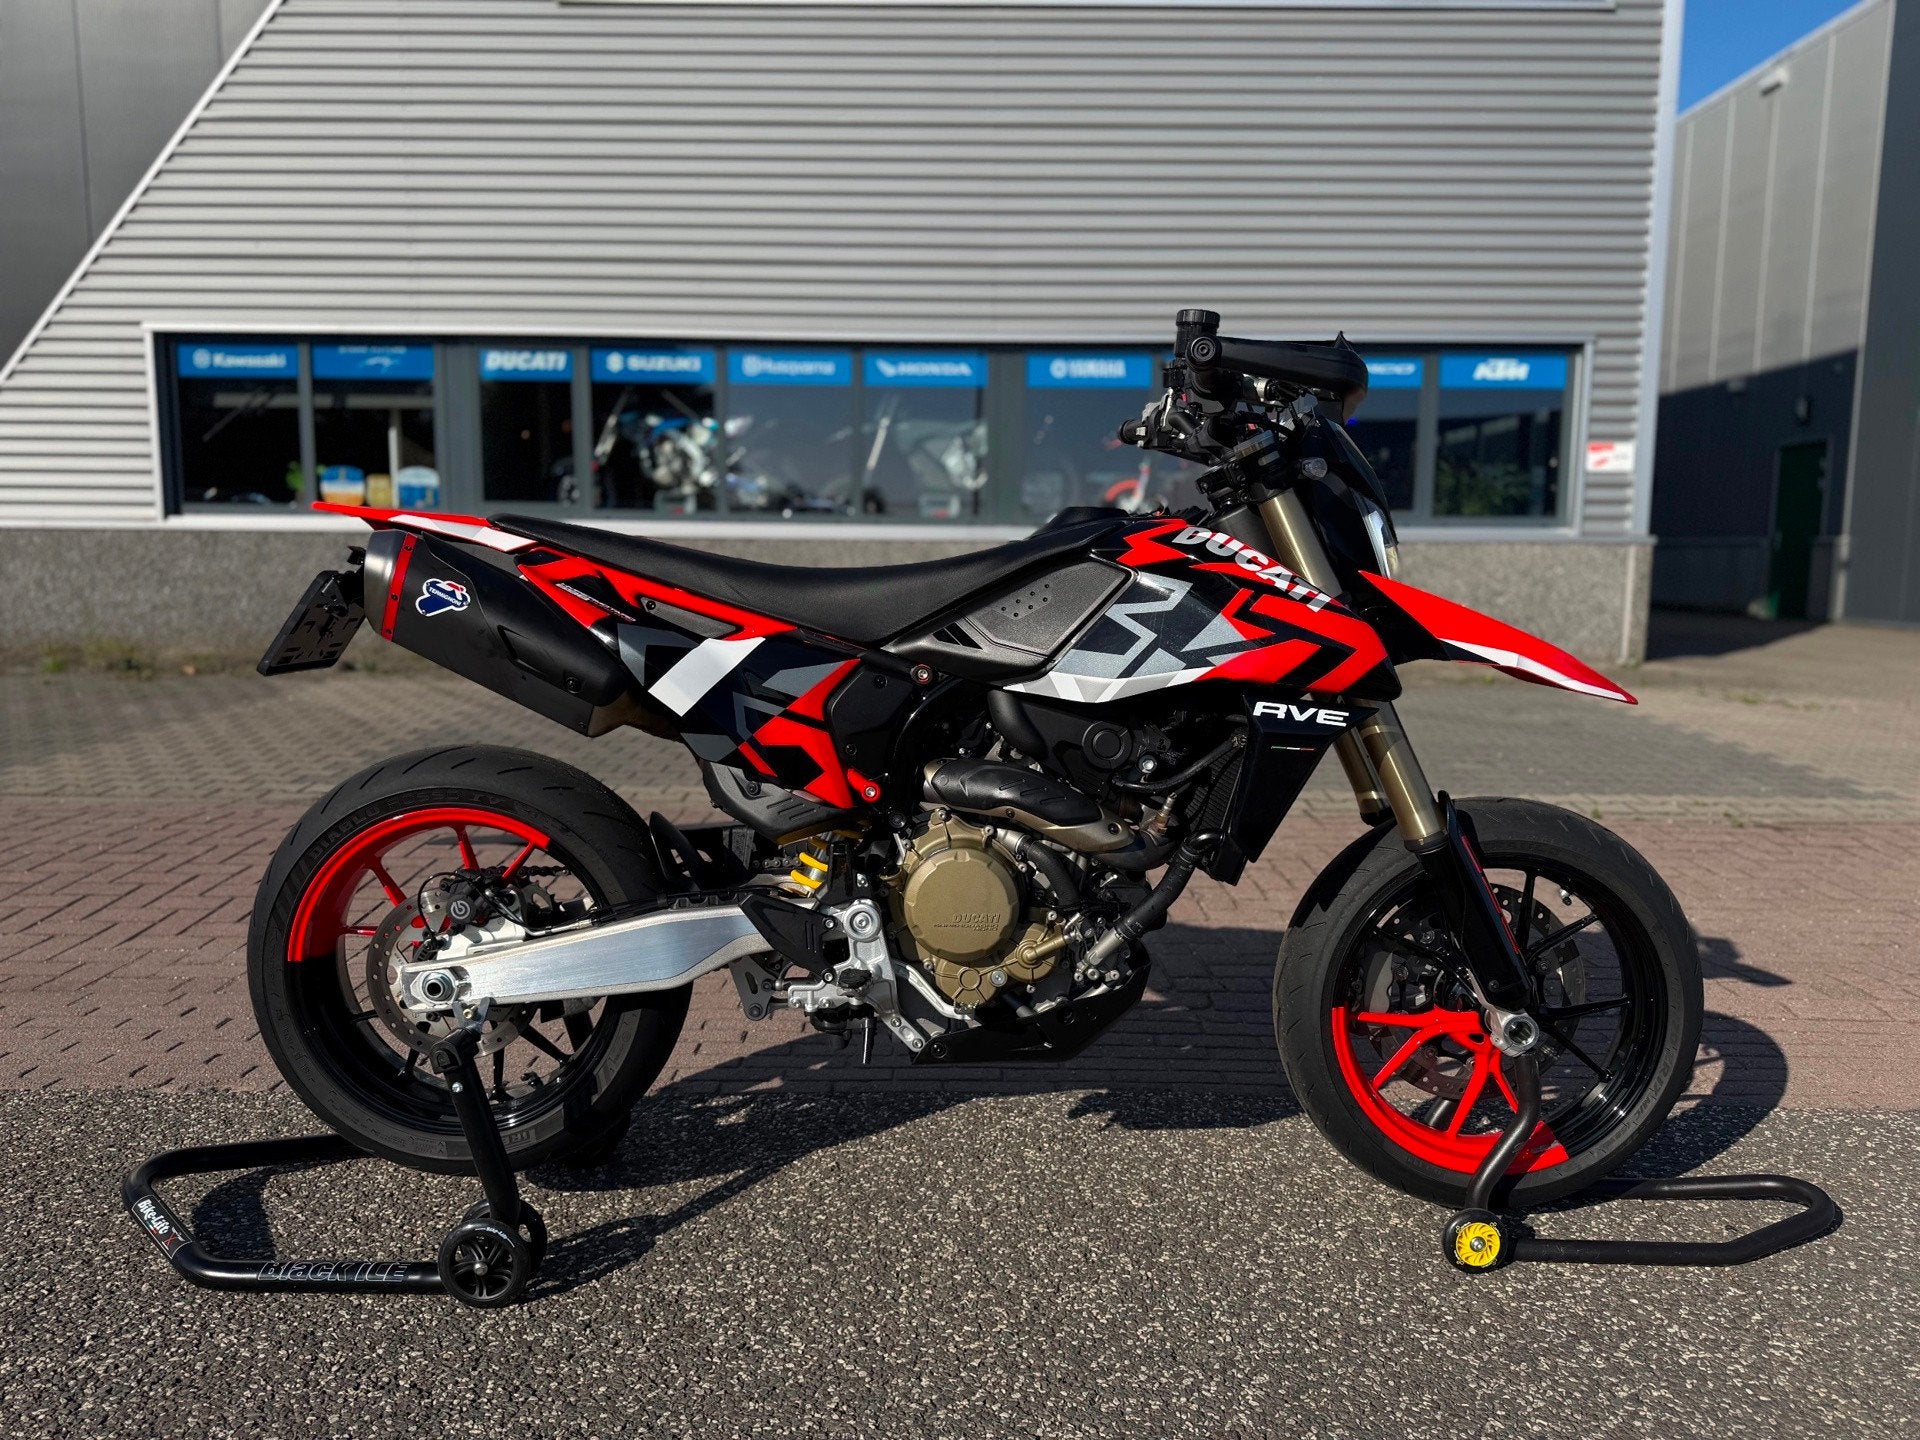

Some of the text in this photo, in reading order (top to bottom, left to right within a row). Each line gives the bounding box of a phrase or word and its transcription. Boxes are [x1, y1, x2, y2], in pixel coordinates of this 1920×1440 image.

[212, 352, 287, 369] Kawasaki
[484, 350, 568, 372] DUCATI
[627, 355, 702, 373] SUZUKI
[1172, 525, 1333, 613] DUCATI
[428, 586, 463, 607] TERMIGNONI
[952, 913, 1001, 924] DUCATI
